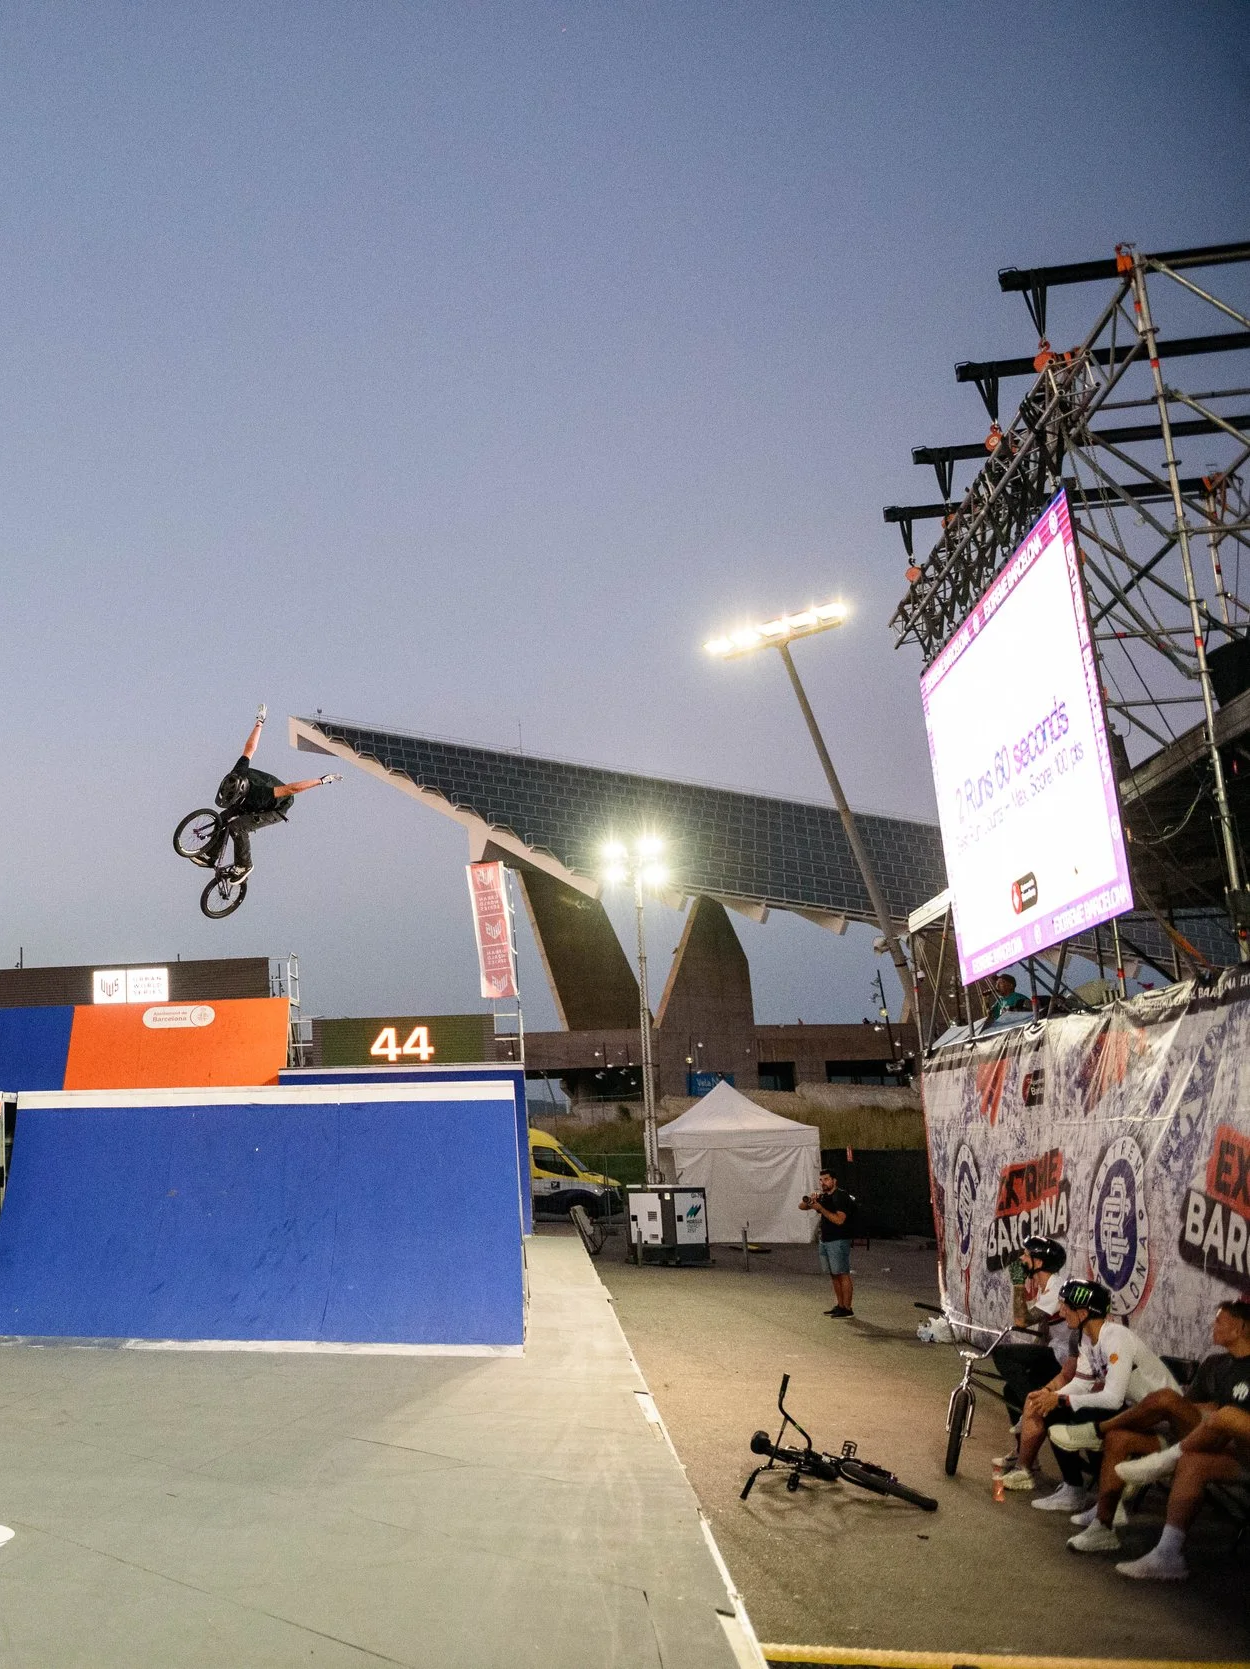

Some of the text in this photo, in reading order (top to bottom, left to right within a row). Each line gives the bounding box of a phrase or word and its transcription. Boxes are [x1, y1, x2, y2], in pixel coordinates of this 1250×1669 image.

[994, 744, 1011, 790] 60
[1012, 694, 1070, 776] seconds
[370, 1026, 435, 1062] 44
[1185, 1190, 1250, 1276] BAR
